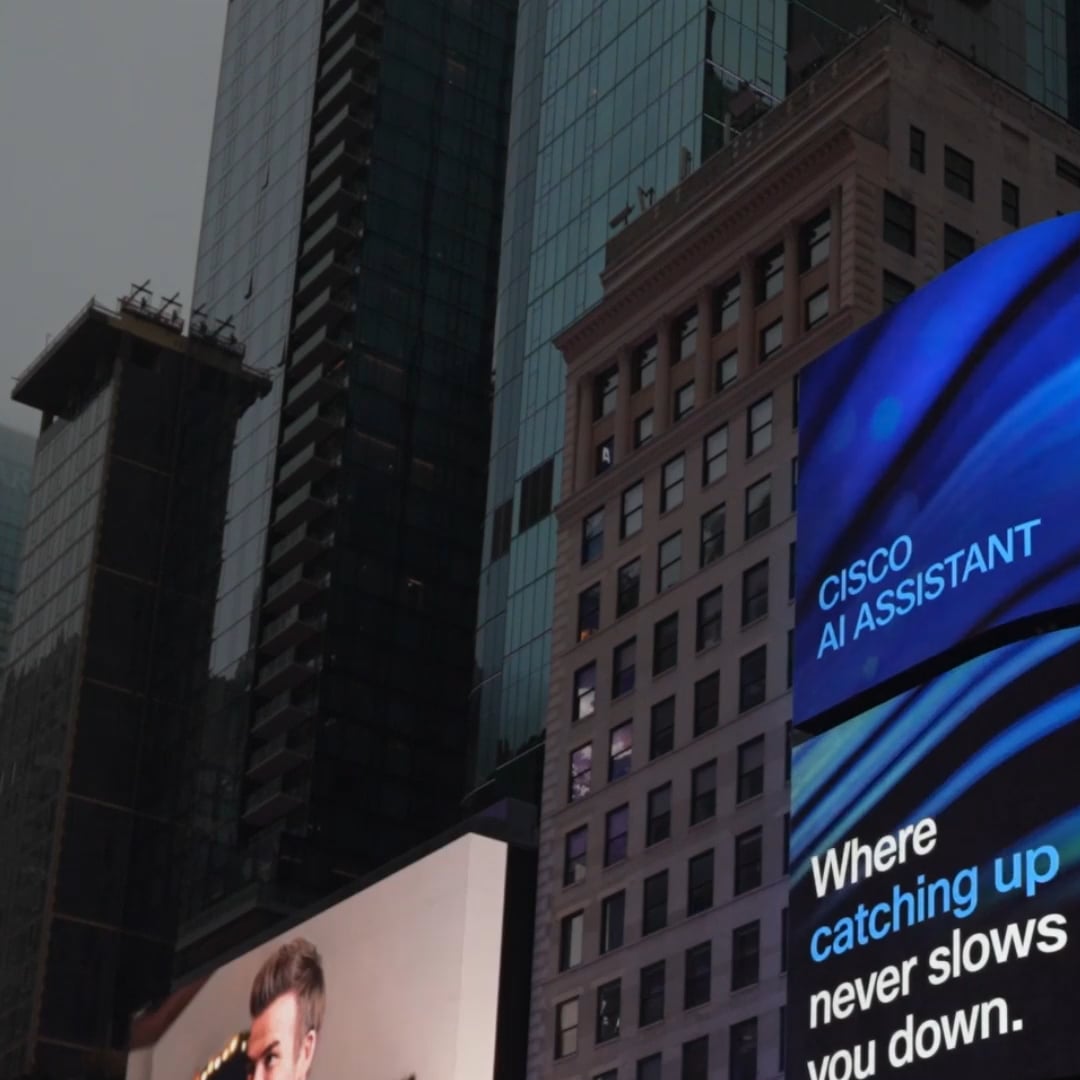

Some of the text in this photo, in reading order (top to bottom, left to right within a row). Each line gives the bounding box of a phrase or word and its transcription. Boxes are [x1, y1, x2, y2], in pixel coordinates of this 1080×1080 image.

[816, 519, 1042, 659] AI ASSISTANT
[818, 534, 913, 611] CISCO
[809, 844, 1060, 963] catching up
[810, 816, 937, 898] Where
[809, 911, 1068, 1029] never slows
[888, 995, 1023, 1068] down.
